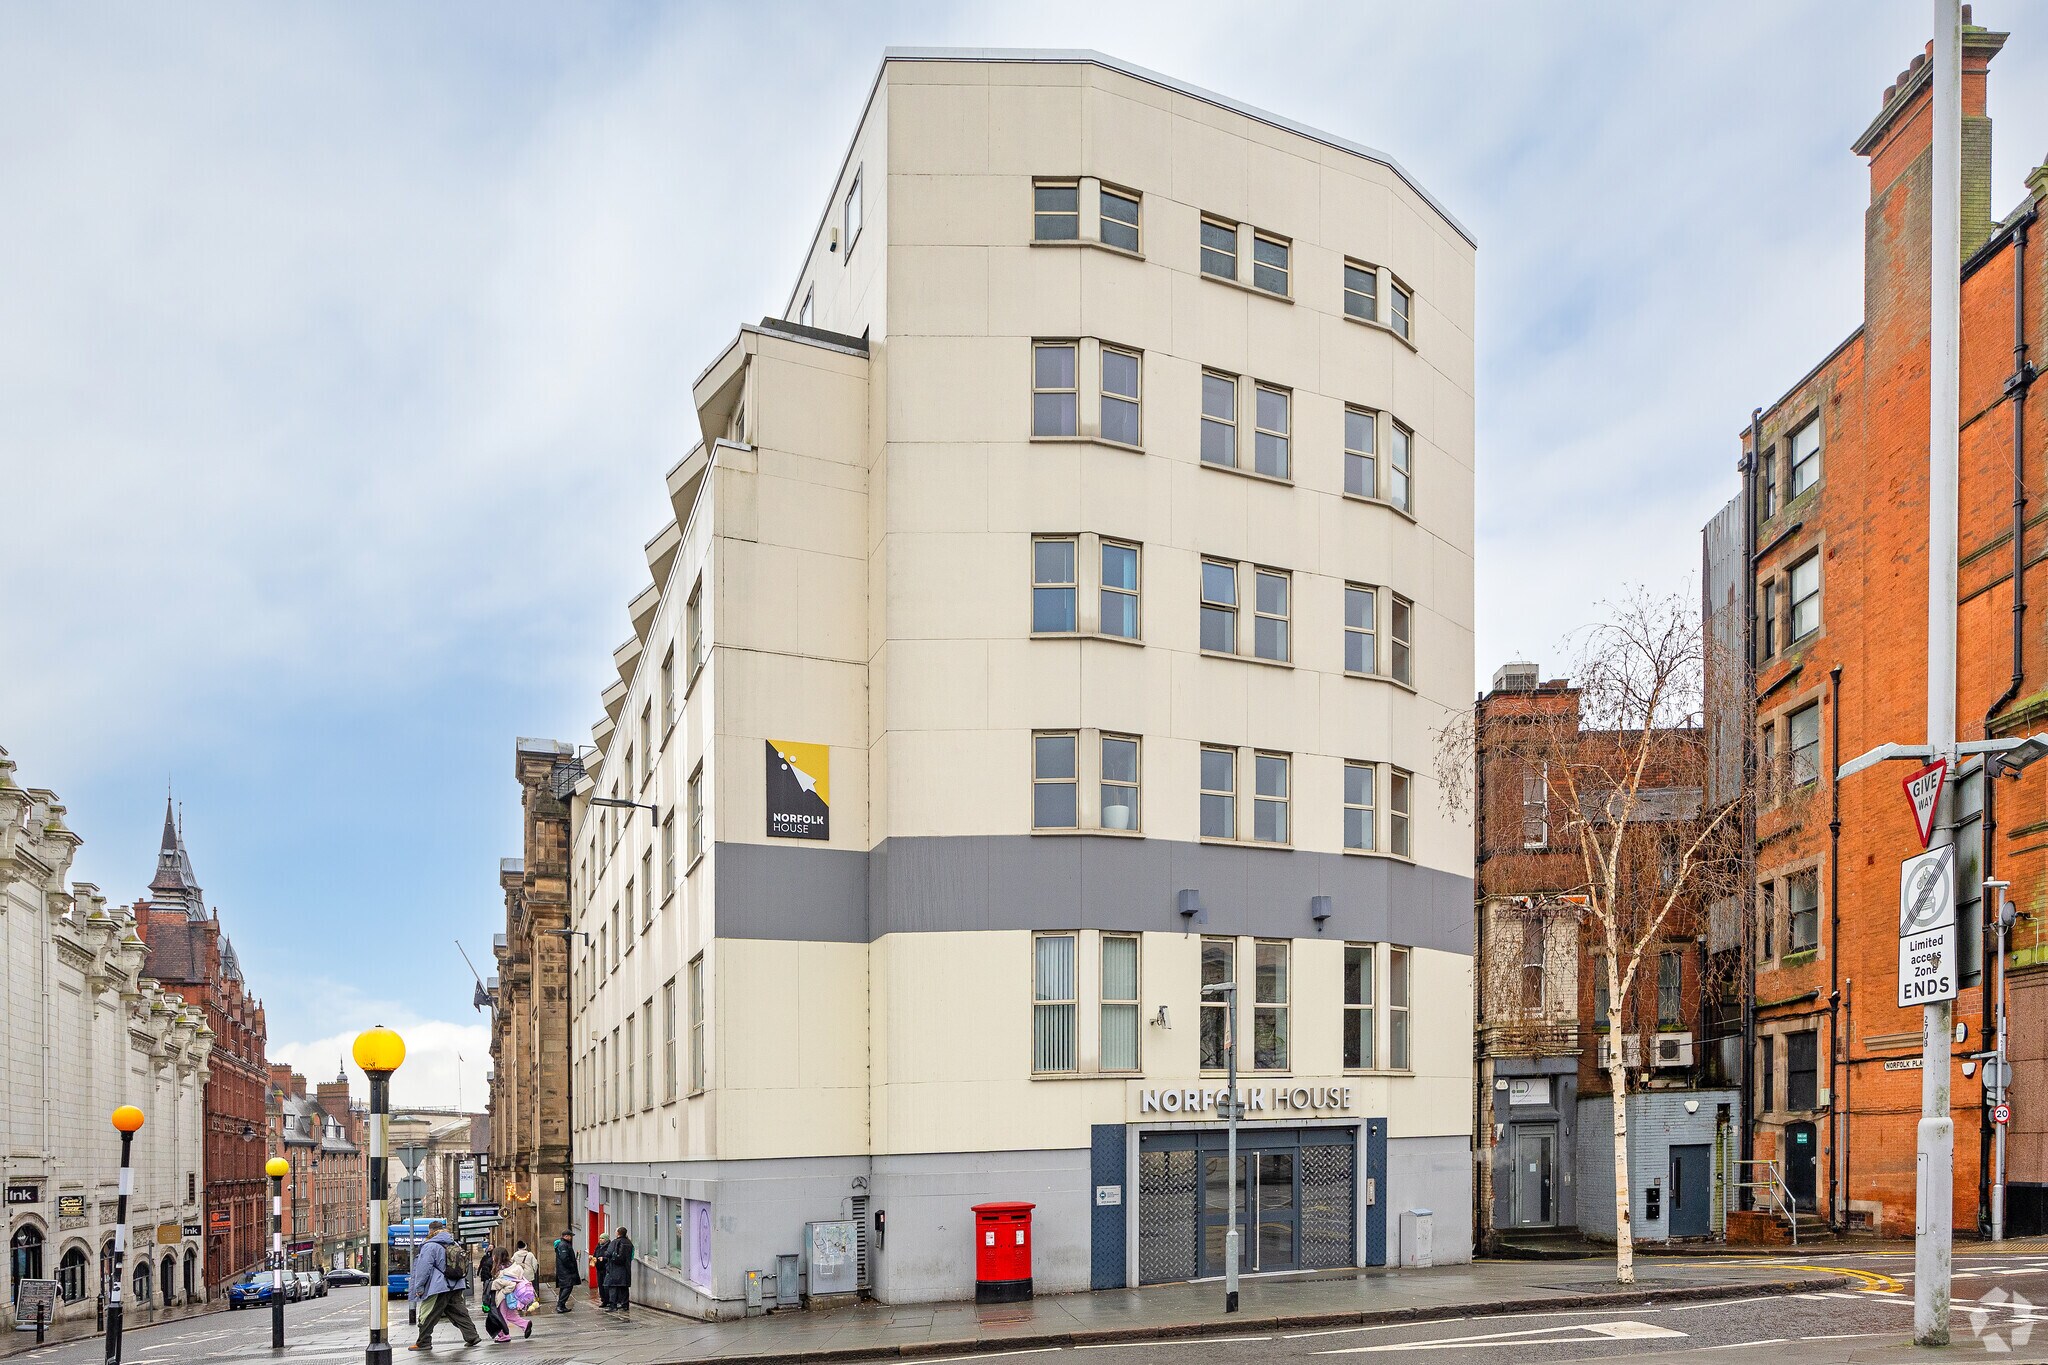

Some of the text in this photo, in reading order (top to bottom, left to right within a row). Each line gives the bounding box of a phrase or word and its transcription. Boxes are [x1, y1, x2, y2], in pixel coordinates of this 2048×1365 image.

[1913, 772, 1937, 797] GIVE
[1918, 795, 1933, 810] WAY
[773, 813, 823, 824] NORFOLK
[773, 823, 809, 833] HOUSE
[1910, 935, 1943, 951] Limited
[1911, 951, 1942, 964] access
[1915, 966, 1937, 977] Zone
[1904, 976, 1949, 999] ENDS
[1886, 1060, 1909, 1069] NORFOLK
[1272, 1087, 1350, 1110] HOUSE
[1996, 1110, 2008, 1118] 20
[9, 1189, 32, 1201] Ink
